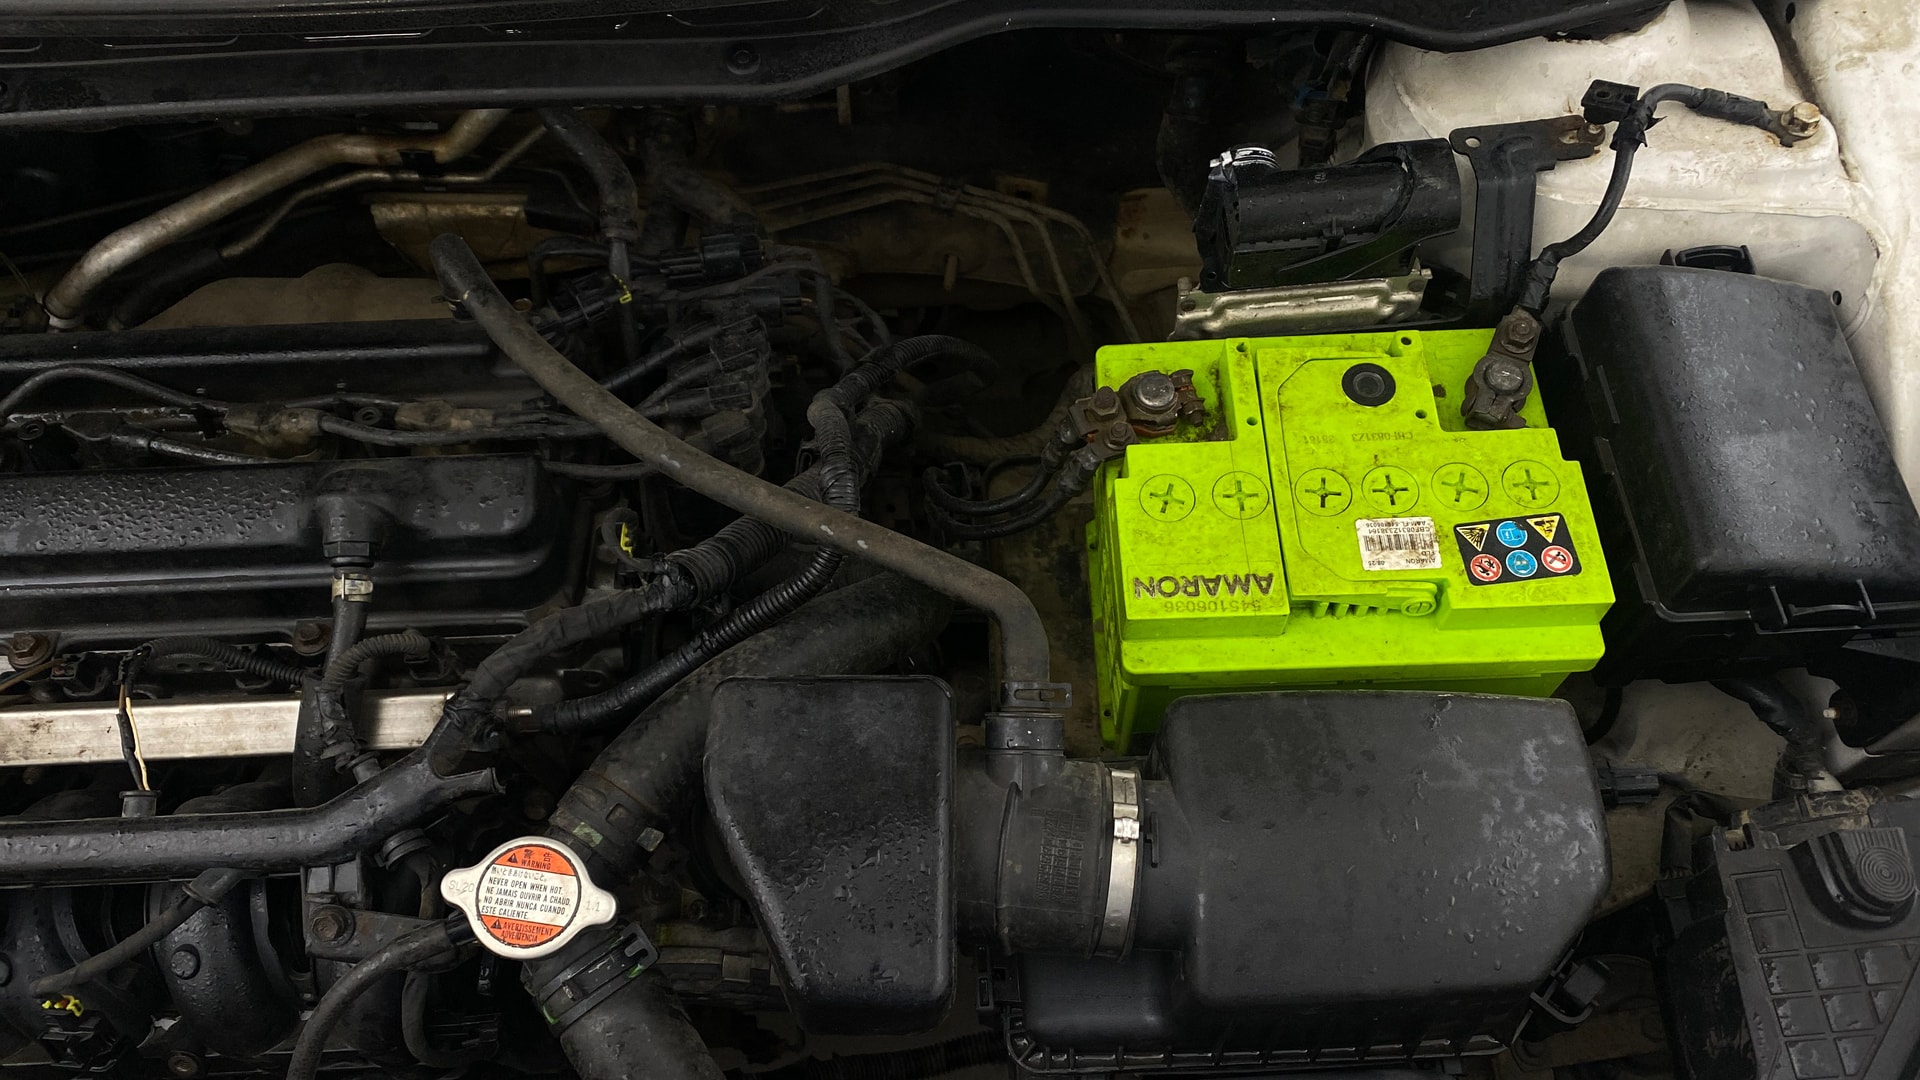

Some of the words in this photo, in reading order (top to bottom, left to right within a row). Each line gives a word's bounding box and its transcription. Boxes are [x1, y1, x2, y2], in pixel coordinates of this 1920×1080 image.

[1133, 573, 1274, 600] AMARON
[1163, 600, 1261, 613] 545106036
[520, 859, 552, 870] WARNING
[488, 876, 509, 886] NEVER
[511, 880, 528, 889] OPEN
[530, 882, 548, 893] WHEN
[549, 886, 563, 895] HOT.
[485, 886, 495, 894] NE
[495, 887, 518, 898] JAMAIS
[519, 891, 542, 901] OUVRIR
[483, 896, 493, 904] NO
[494, 897, 515, 907] ABRIR
[515, 900, 538, 910] NUNCA
[481, 905, 498, 914] ESTE
[498, 907, 529, 919] CALIENTE.
[502, 921, 554, 936] AVERTISSEMENT
[501, 929, 538, 943] ADVERTENCIA
